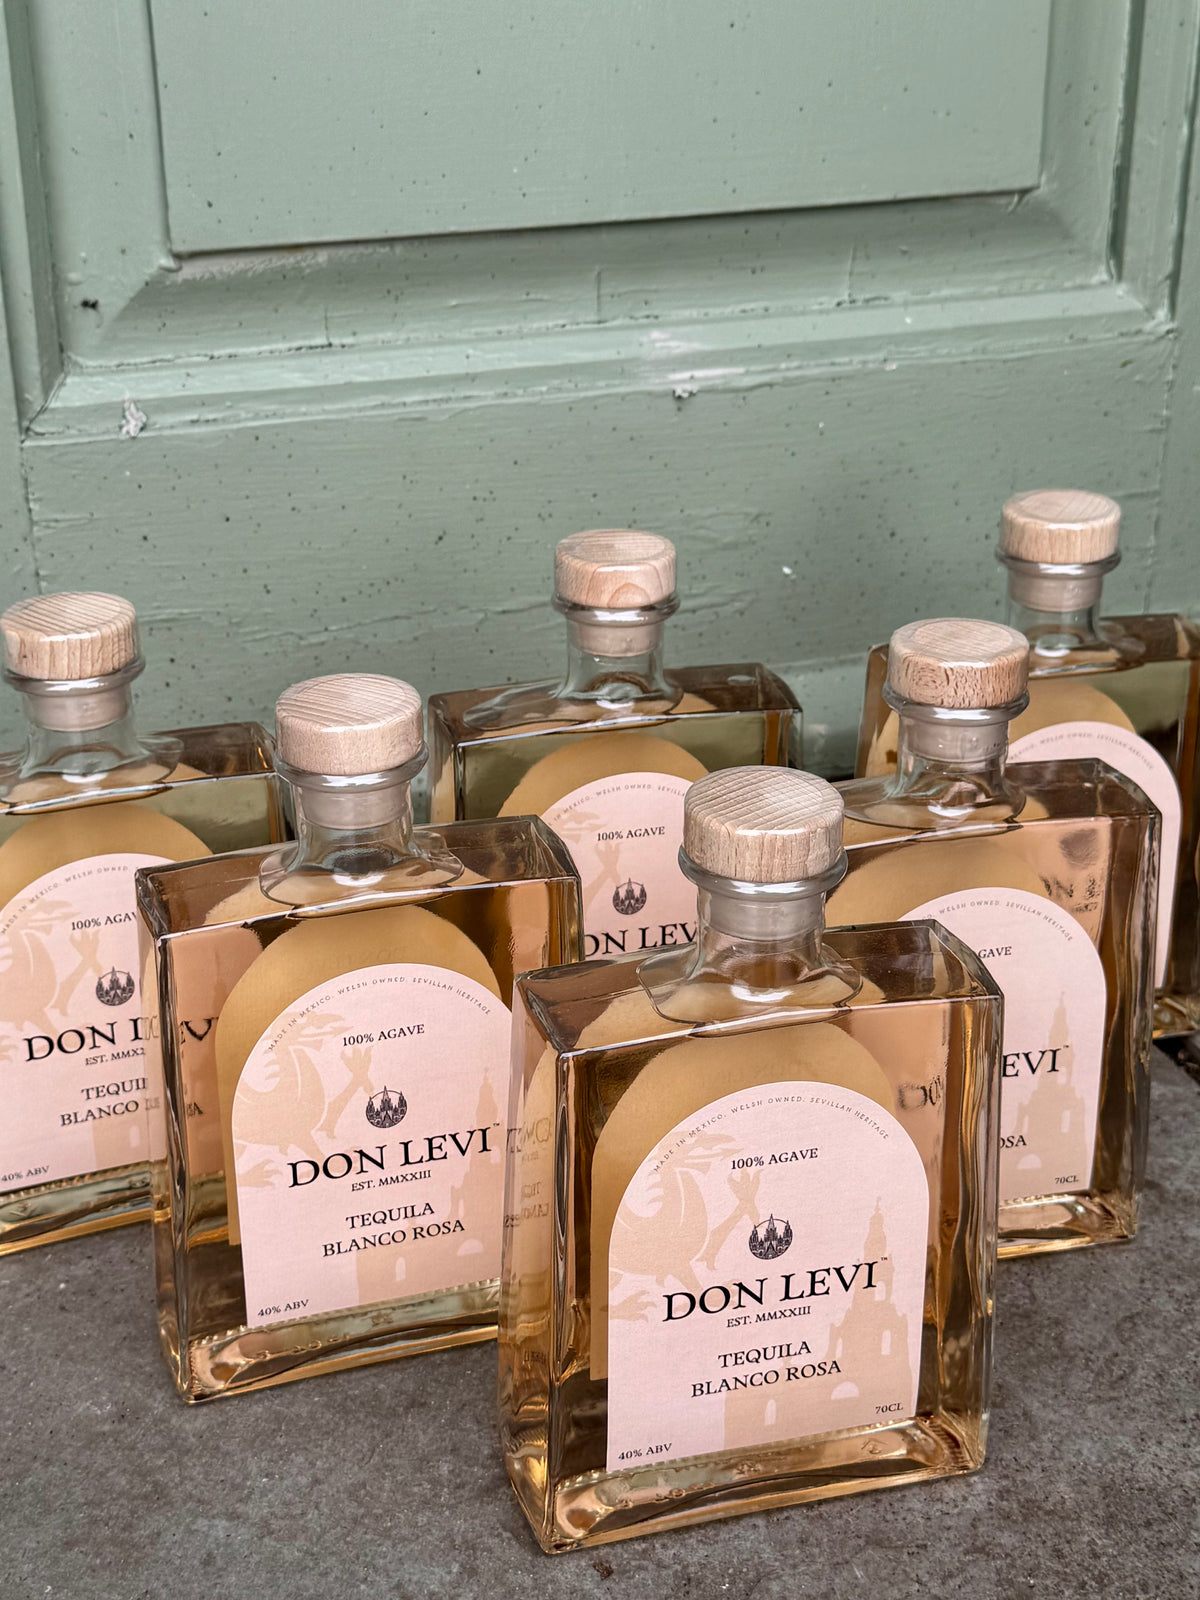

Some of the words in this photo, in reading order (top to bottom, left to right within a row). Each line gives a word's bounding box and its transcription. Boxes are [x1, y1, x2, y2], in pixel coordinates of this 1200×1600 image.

[597, 831, 623, 841] 100%
[626, 826, 665, 839] AGAVE
[71, 917, 101, 931] 100%
[585, 929, 628, 957] ON
[638, 921, 697, 949] LEV
[978, 946, 1012, 958] GAVE
[268, 1029, 287, 1051] MADE
[338, 982, 367, 994] WELSH
[413, 977, 453, 991] SEVILLAN
[23, 1021, 118, 1062] DON
[343, 1033, 374, 1047] 100%
[378, 1024, 425, 1041] AGAVE
[85, 1055, 108, 1066] EST.
[60, 1100, 139, 1127] BLANCO
[654, 1149, 674, 1172] MADE
[676, 1138, 686, 1148] IN
[731, 1100, 762, 1113] WELSH
[810, 1097, 852, 1113] SEVILLAN
[854, 1110, 889, 1139] HERITAGE
[287, 1144, 387, 1188] DON
[731, 1156, 764, 1170] 100%
[768, 1148, 818, 1165] AGAVE
[26, 1165, 50, 1177] ABV
[351, 1179, 376, 1192] EST.
[378, 1170, 431, 1187] MMXXIII
[1055, 1175, 1079, 1185] 70CL
[346, 1202, 435, 1230] TEQUILA
[322, 1230, 407, 1257] BLANCO
[412, 1219, 465, 1241] ROSA
[258, 1305, 281, 1316] 40%
[284, 1299, 309, 1311] ABV
[662, 1277, 768, 1322] DON
[726, 1315, 752, 1328] EST.
[755, 1306, 811, 1324] MMXXIII
[718, 1341, 812, 1368] TEQUILA
[691, 1370, 780, 1398] BLANCO
[785, 1360, 842, 1381] ROSA
[875, 1403, 904, 1414] 70CL
[618, 1449, 642, 1460] 40%
[646, 1442, 672, 1455] ABV
